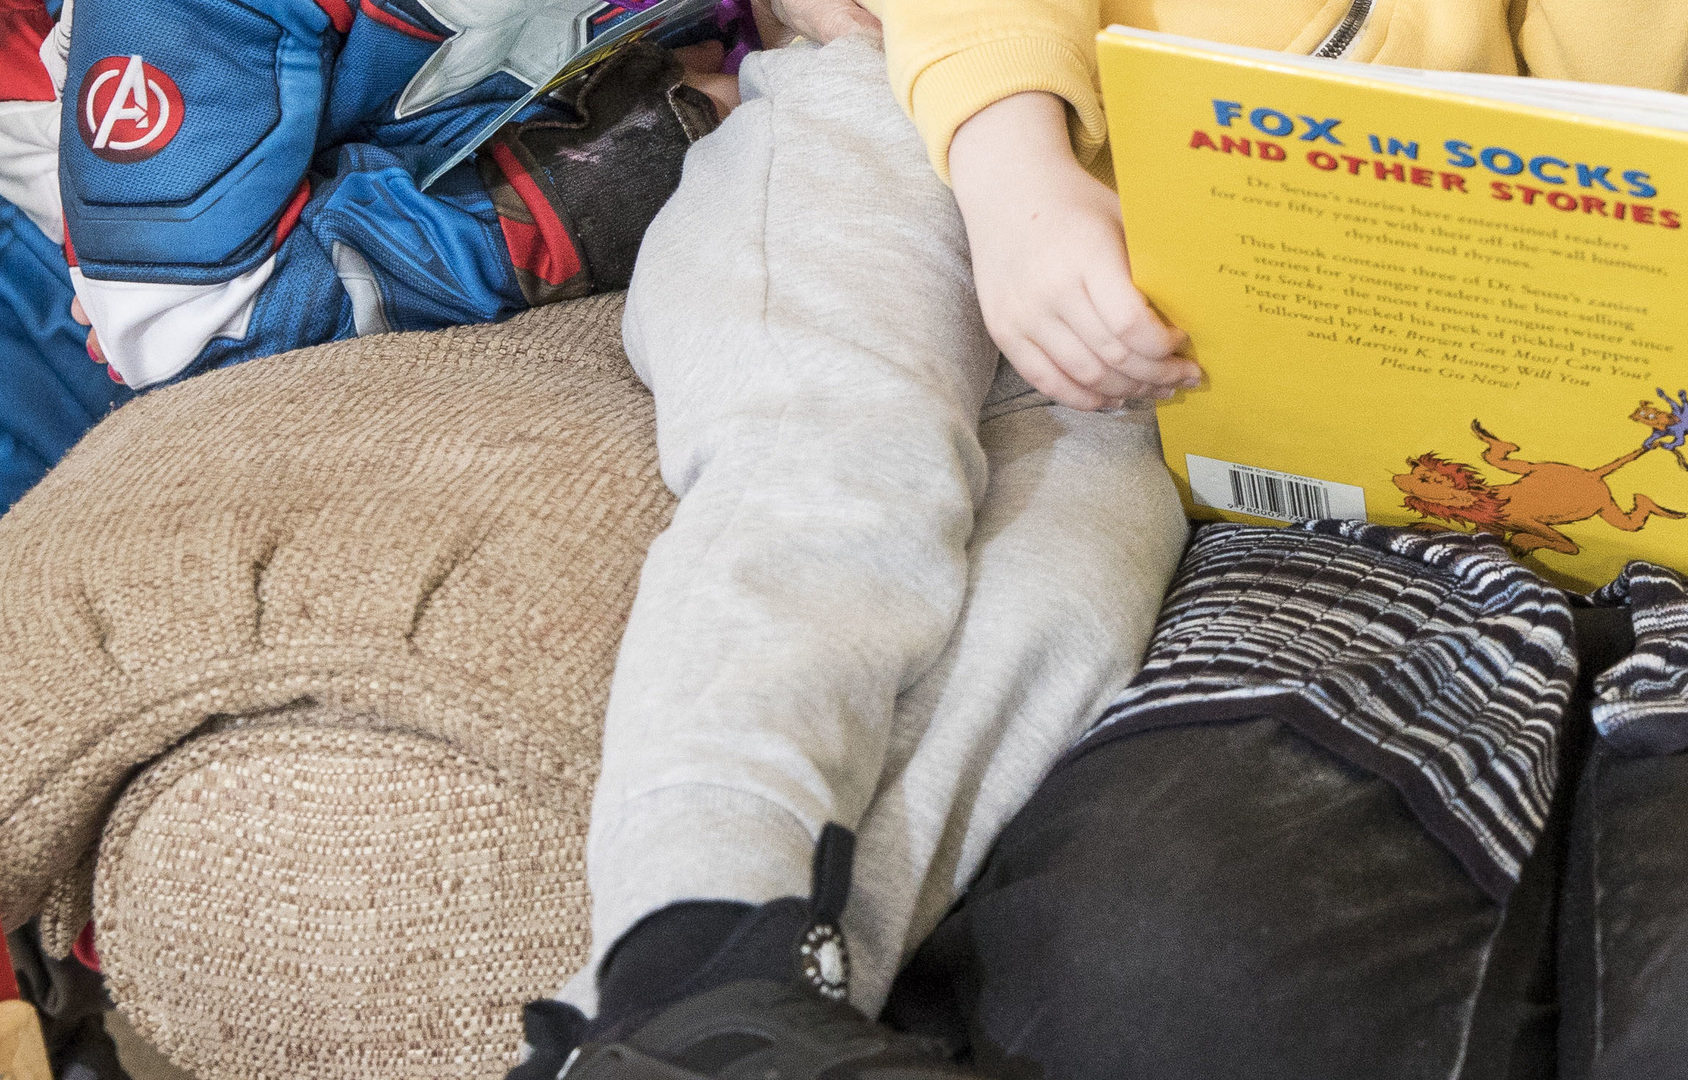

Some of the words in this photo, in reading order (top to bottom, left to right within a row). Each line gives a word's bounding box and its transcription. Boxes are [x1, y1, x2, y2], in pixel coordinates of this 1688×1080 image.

[1190, 129, 1287, 161] AND
[1306, 150, 1468, 194] OTHER
[1489, 181, 1681, 229] STORIES
[1212, 99, 1343, 146] FOX
[1369, 134, 1419, 160] IN
[1444, 140, 1657, 198] SOCKS
[1210, 186, 1236, 200] for
[1242, 196, 1281, 208] over
[1288, 200, 1324, 218] fifty
[1333, 212, 1378, 225] years
[1384, 220, 1424, 233] with
[1430, 226, 1471, 241] their
[1247, 176, 1270, 189] Dr.
[1280, 182, 1341, 202] Seuss's
[1347, 197, 1405, 213] stories
[1411, 205, 1451, 221] have
[1457, 216, 1558, 239] entertained
[1565, 234, 1629, 251] readers
[1345, 228, 1419, 249] rhythms
[1426, 245, 1457, 256] and
[1236, 234, 1275, 250] This
[1281, 241, 1326, 259] book
[1332, 255, 1406, 273] contains
[1412, 266, 1456, 281] three
[1462, 276, 1480, 286] of
[1488, 278, 1514, 291] Dr.
[1521, 284, 1581, 303] Seuss's
[1254, 256, 1310, 272] stories
[1316, 264, 1341, 278] for
[1349, 274, 1420, 292] younger
[1501, 298, 1527, 310] the
[1217, 264, 1248, 277] Fox
[1255, 273, 1271, 282] in
[1278, 275, 1323, 291] Socks
[1343, 286, 1370, 299] the
[1376, 295, 1418, 308] most
[1425, 301, 1489, 320] famous
[1631, 338, 1674, 353] since
[1244, 284, 1287, 301] Peter
[1295, 293, 1340, 310] Piper
[1347, 306, 1404, 322] picked
[1410, 314, 1435, 327] his
[1441, 323, 1480, 335] peck
[1487, 330, 1505, 339] of
[1511, 334, 1575, 352] pickled
[1581, 347, 1650, 365] peppers
[1258, 303, 1334, 325] followed
[1340, 317, 1361, 332] by
[1370, 323, 1395, 335] Mr.
[1406, 330, 1463, 348] Brown
[1470, 342, 1506, 356] Can
[1514, 349, 1559, 364] Moo!
[1565, 358, 1602, 373] Can
[1610, 365, 1652, 381] You?
[1307, 331, 1338, 342] and
[1345, 335, 1408, 355] Marvin
[1415, 346, 1432, 360] K.
[1441, 353, 1509, 374] Mooney
[1517, 365, 1552, 380] Will
[1560, 373, 1590, 387] You
[1380, 357, 1432, 374] Please
[1438, 368, 1465, 380] Go
[1471, 373, 1520, 390] Now!
[1232, 463, 1254, 473] ISBN
